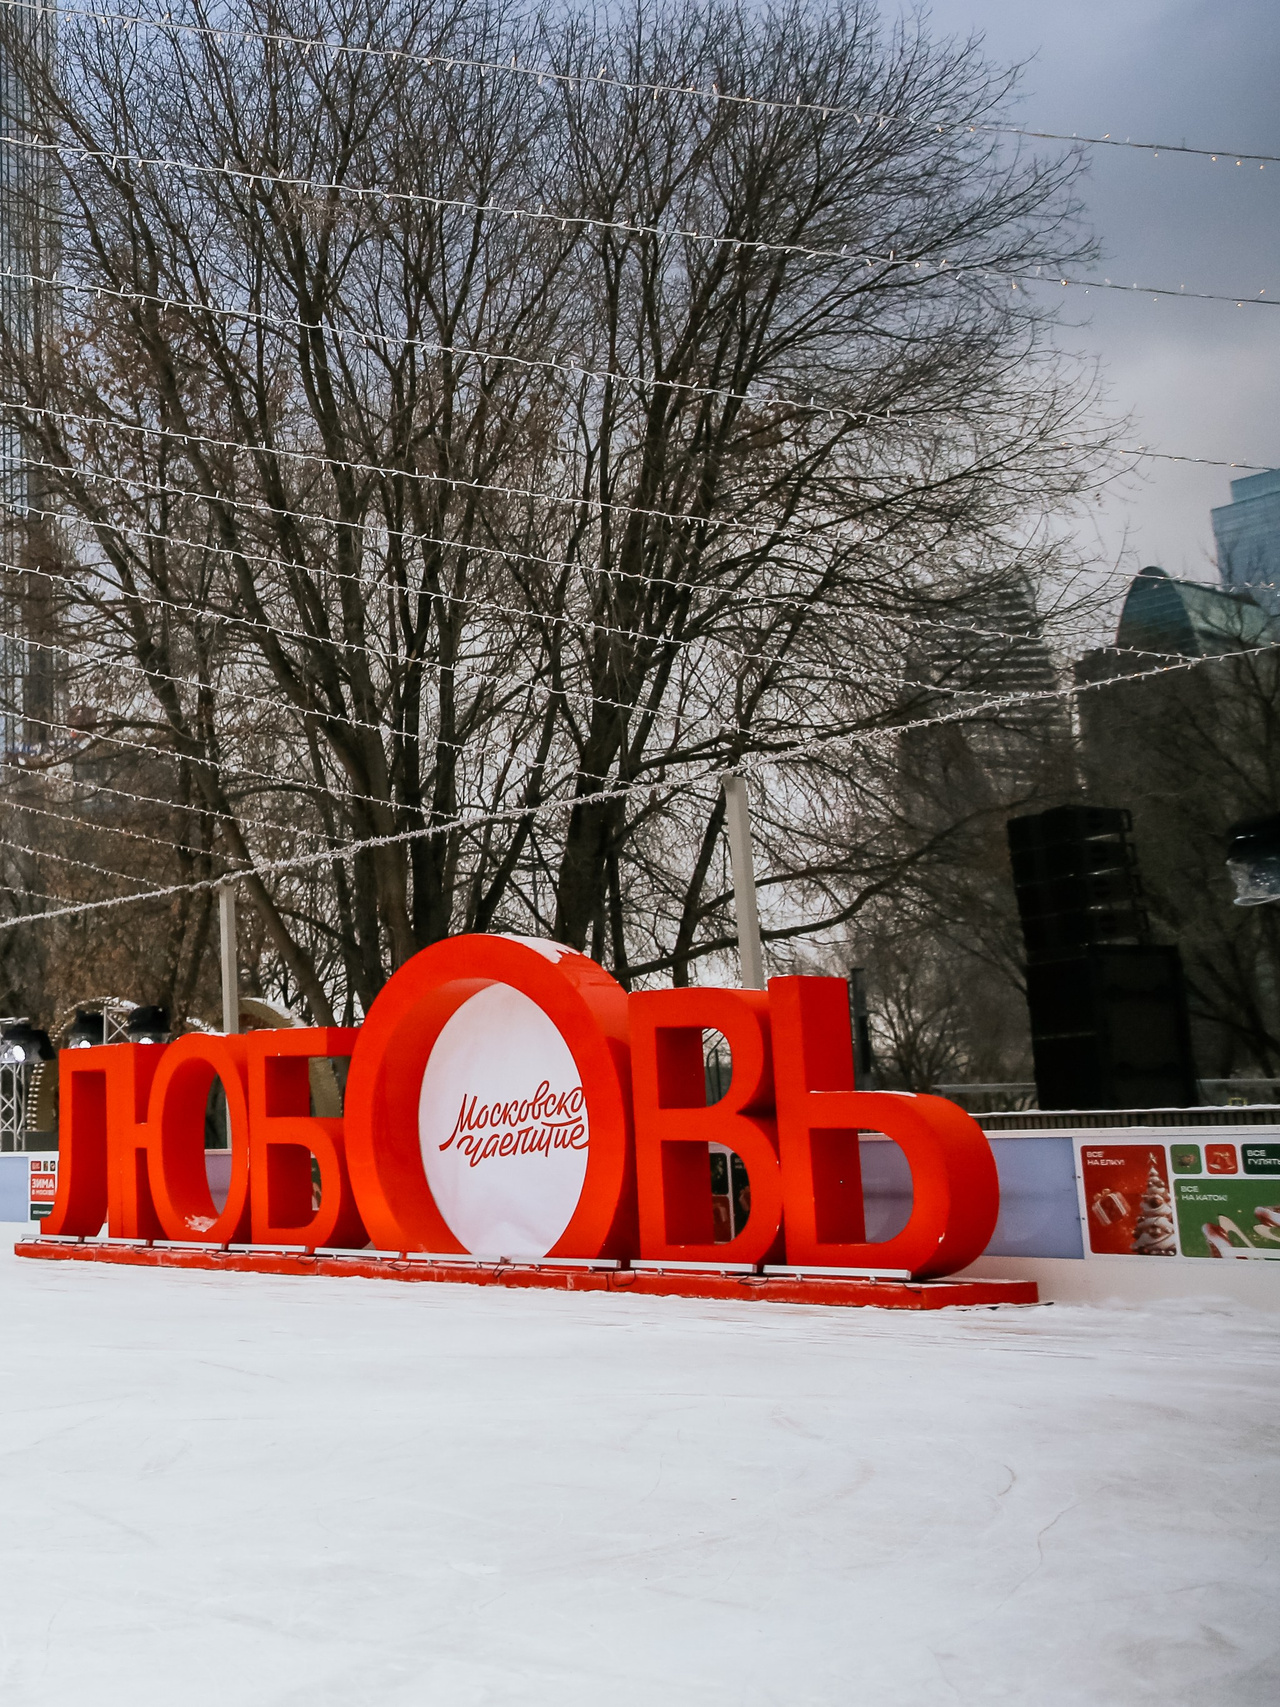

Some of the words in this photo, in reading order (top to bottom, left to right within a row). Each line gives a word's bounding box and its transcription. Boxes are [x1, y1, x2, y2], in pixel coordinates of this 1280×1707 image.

[40, 933, 999, 1280] ЛЮБОВЬ
[439, 1080, 586, 1151] Московско
[457, 1116, 589, 1167] чаепитие
[1247, 1149, 1266, 1157] ВСЕ
[32, 1178, 54, 1189] ЗИМА
[1180, 1185, 1199, 1193] ВСЕ
